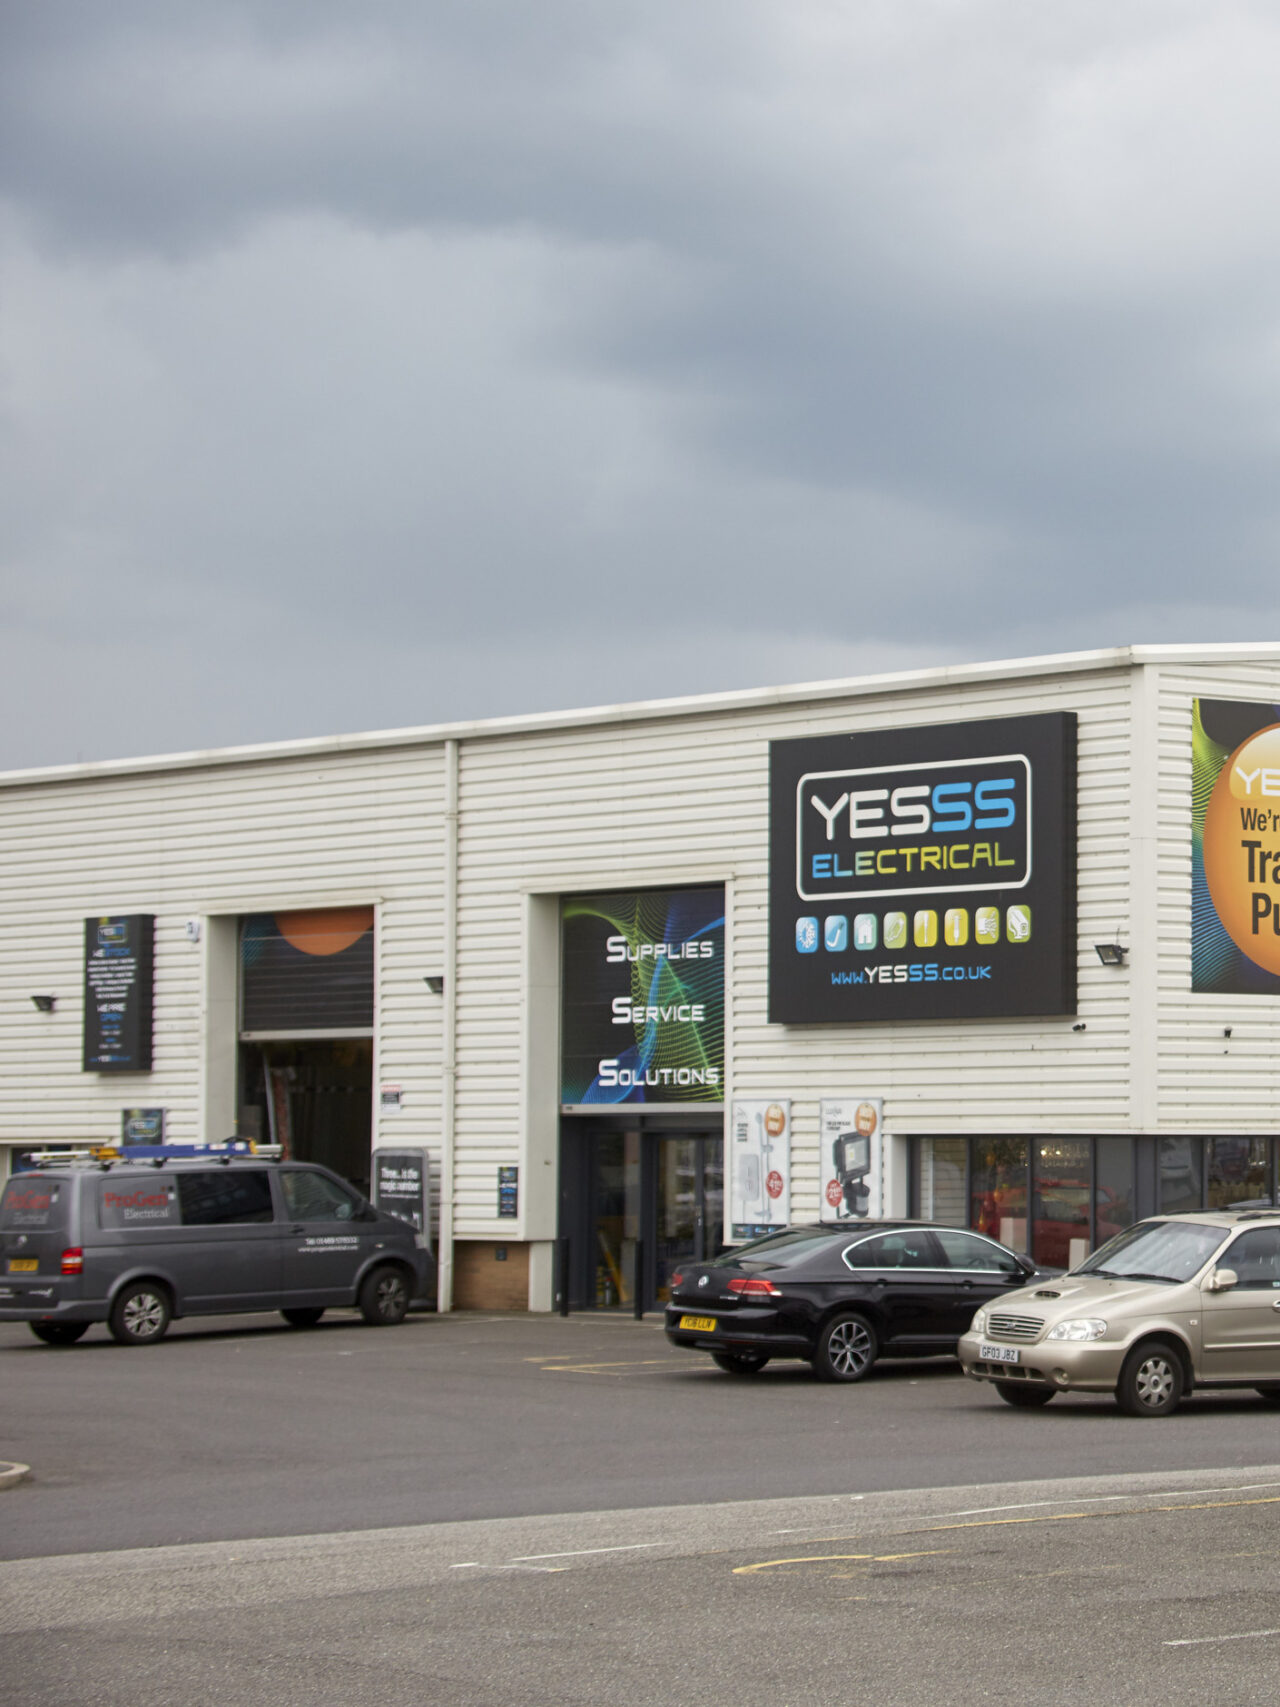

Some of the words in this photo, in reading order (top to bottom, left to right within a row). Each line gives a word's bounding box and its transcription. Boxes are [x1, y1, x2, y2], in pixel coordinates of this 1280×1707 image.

[811, 778, 1016, 841] YESSS
[812, 841, 1016, 879] ELECTRICAL
[606, 935, 714, 962] SUPPLIES
[611, 997, 706, 1024] SERVICE
[598, 1059, 720, 1087] SOLUTIONS
[104, 1191, 169, 1208] ProGen
[124, 1208, 170, 1220] Electrical
[981, 1346, 1001, 1359] GF03
[1001, 1348, 1016, 1361] JBZ
